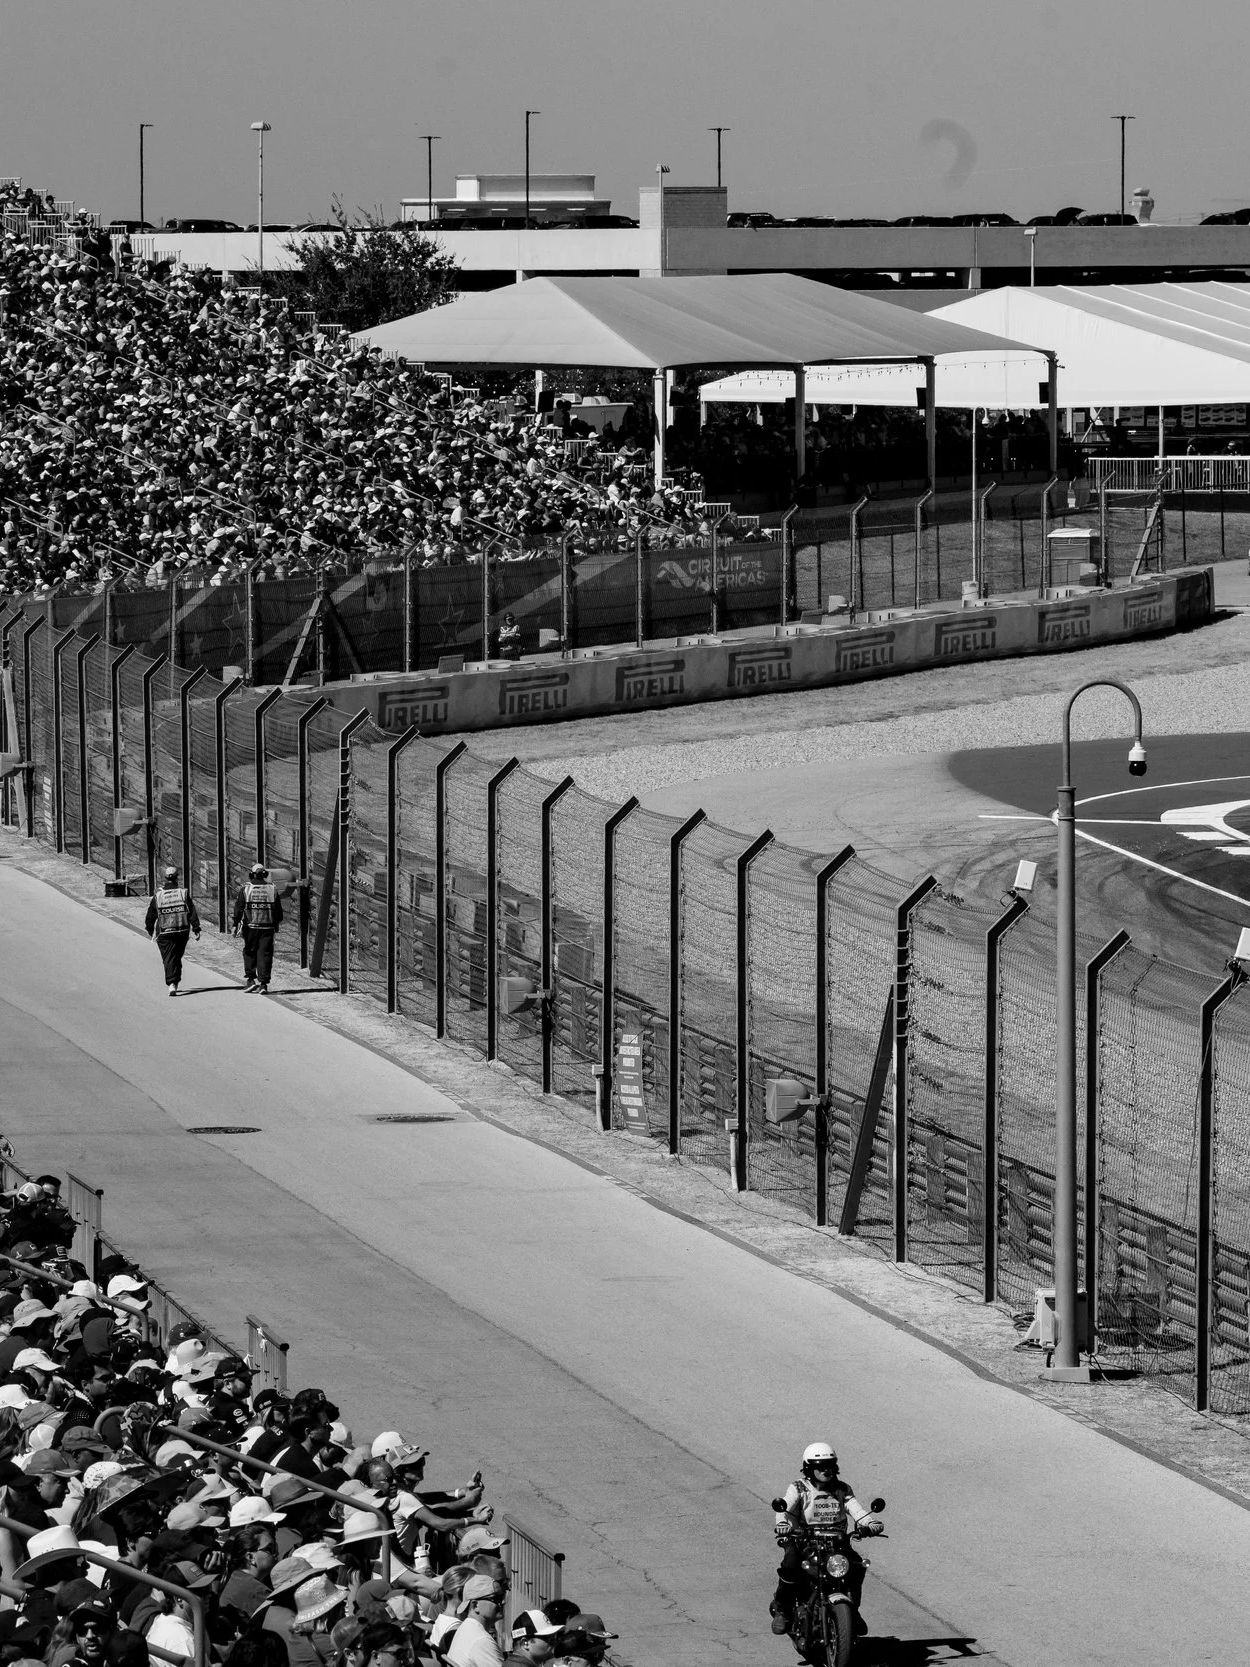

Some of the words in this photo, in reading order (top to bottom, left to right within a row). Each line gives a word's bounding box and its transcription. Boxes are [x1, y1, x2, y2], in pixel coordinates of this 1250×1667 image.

[688, 555, 742, 575] CIRUIT
[750, 560, 763, 569] THE
[1038, 605, 1091, 643] PIRELLI
[1123, 591, 1163, 630] PIRELLI
[835, 630, 896, 673] PIRELLI
[934, 615, 997, 656] PIRELLI
[615, 659, 685, 702] PIRELLI
[727, 646, 792, 687] PIRELLI
[377, 684, 449, 728] PIRELLI
[498, 672, 569, 715] PIRELLI
[161, 905, 185, 914] COURSE
